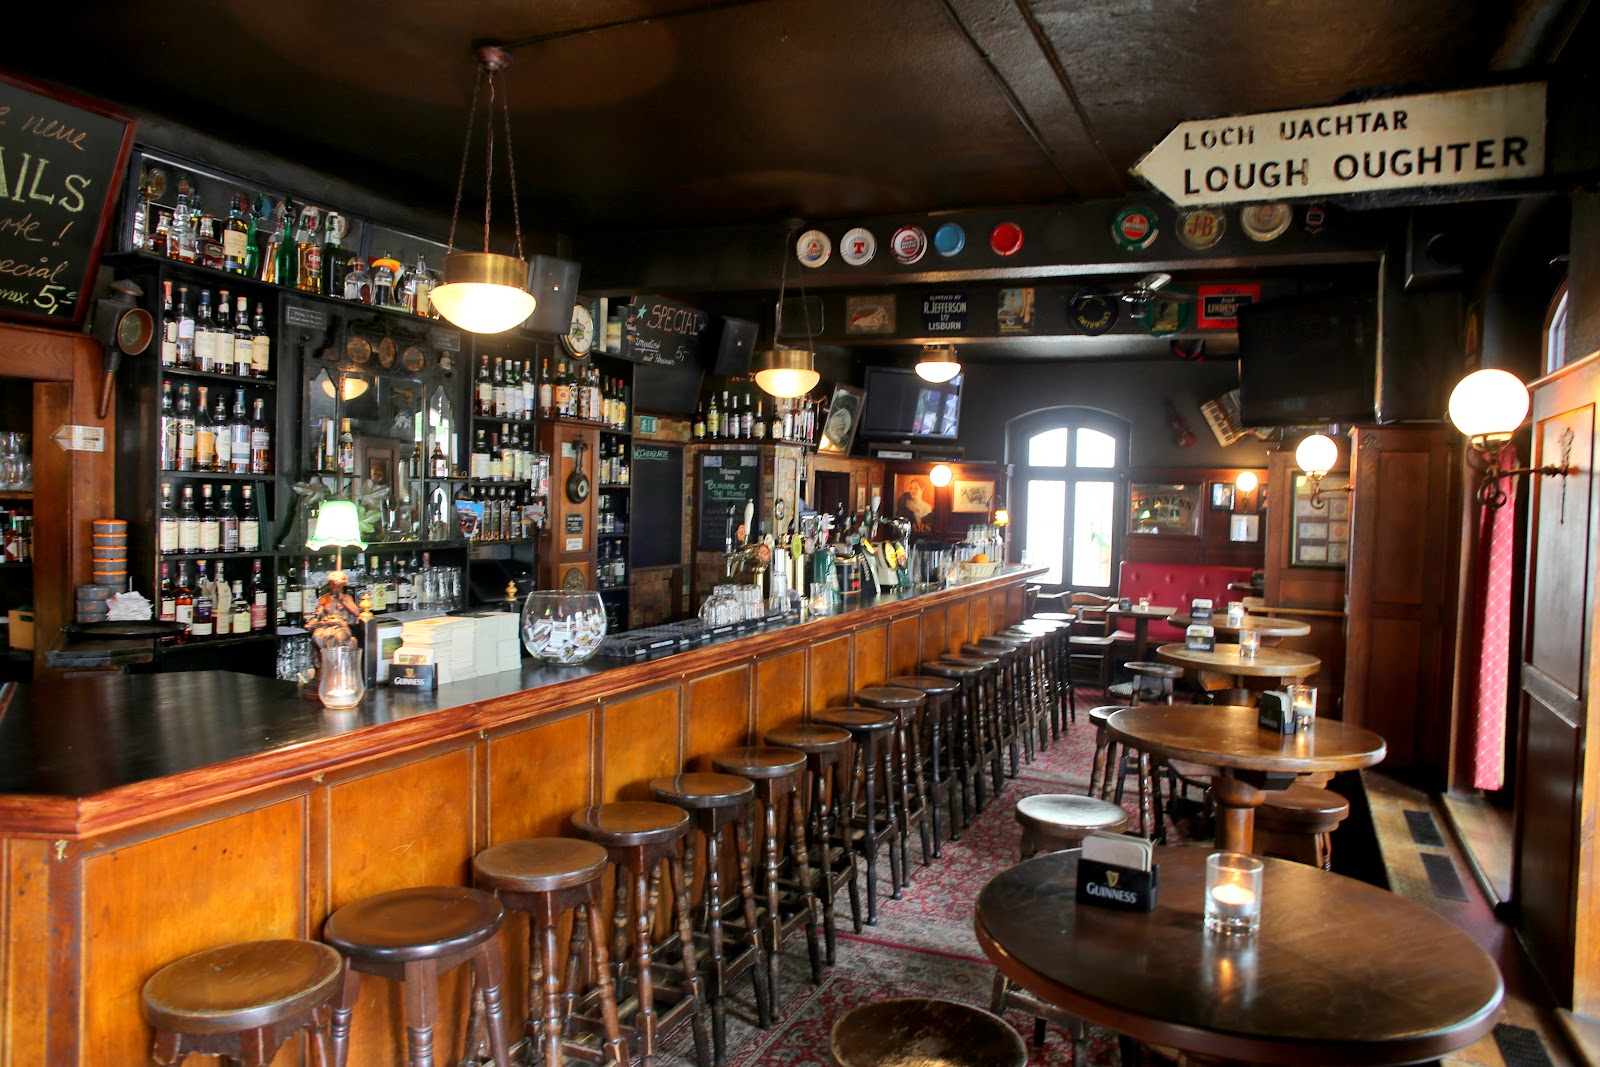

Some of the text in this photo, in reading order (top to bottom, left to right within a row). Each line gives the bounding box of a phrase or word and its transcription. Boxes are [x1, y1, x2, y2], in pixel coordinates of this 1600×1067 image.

[1184, 110, 1408, 151] LOCH UACHTAR
[1184, 137, 1529, 196] LOUGH OUGHTER
[0, 257, 69, 284] ecial
[646, 304, 698, 336] SPECIAL
[928, 321, 962, 331] LISBURN
[394, 676, 425, 686] GUINNESS
[1086, 881, 1137, 904] GUINNESS
